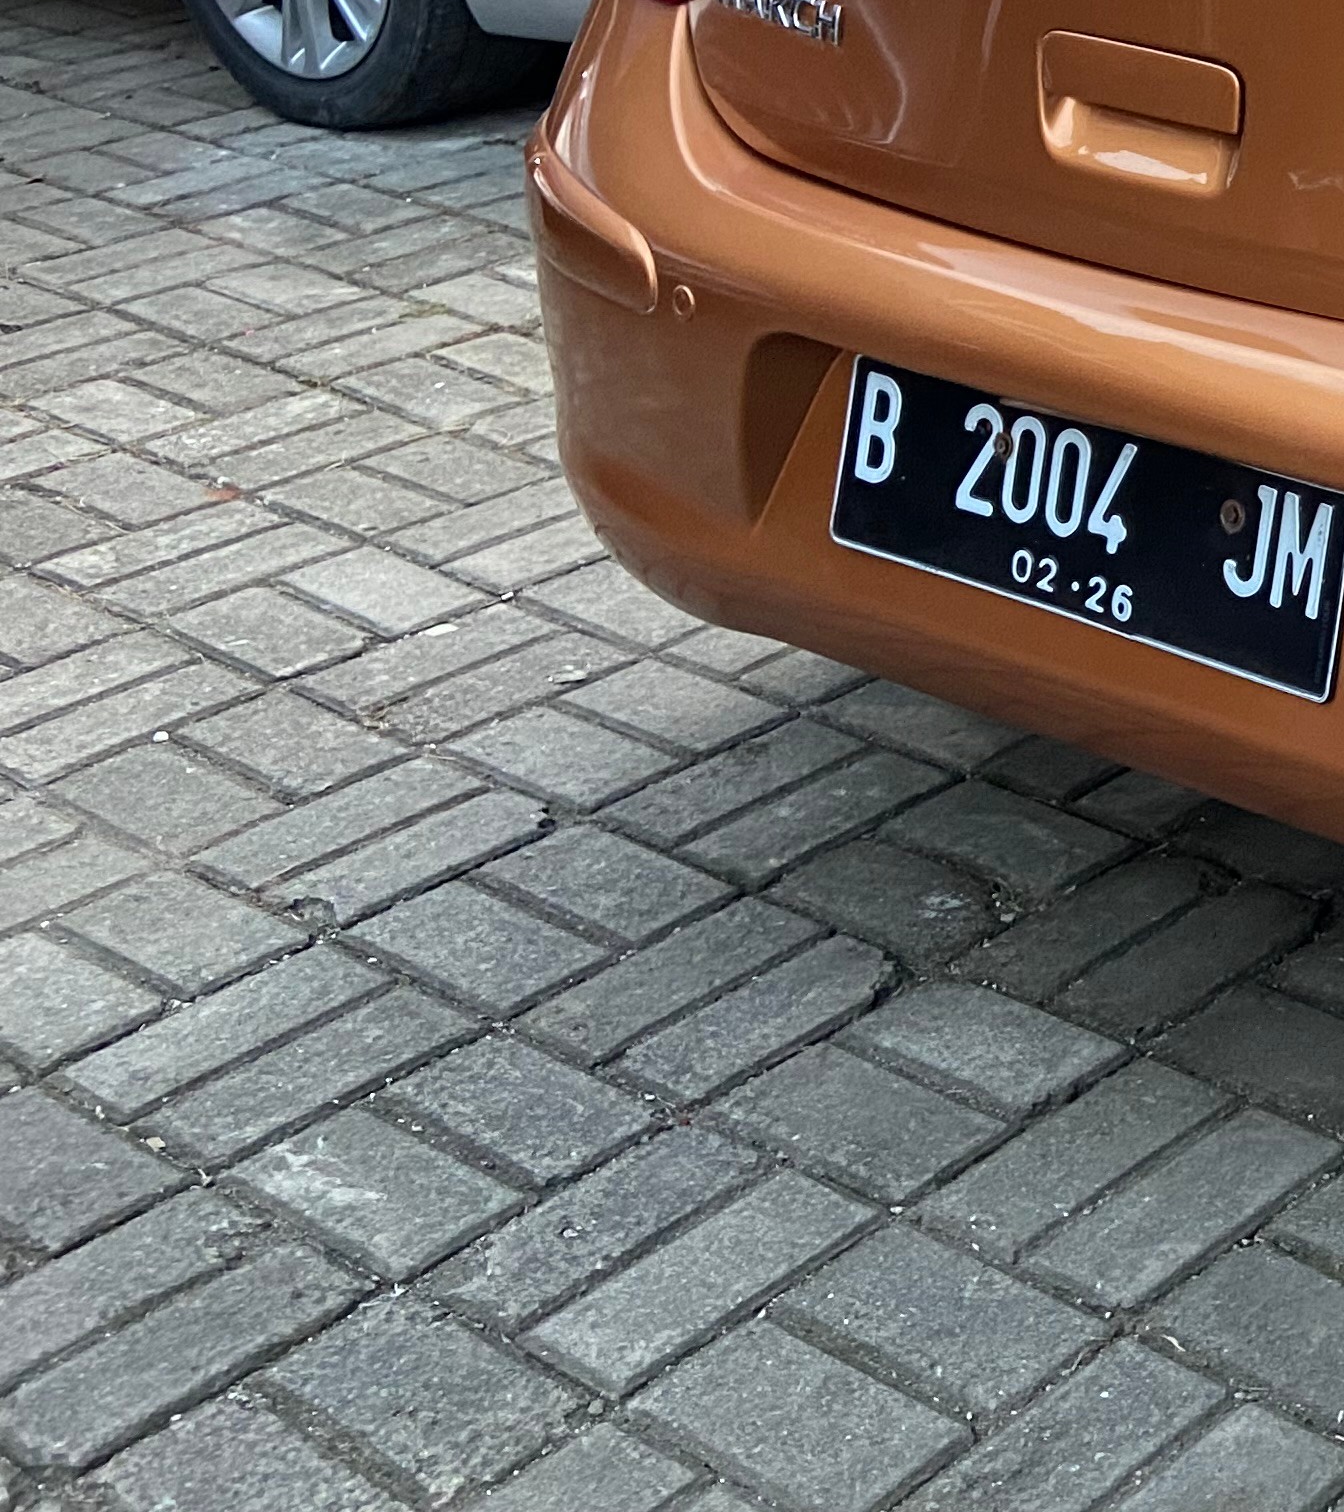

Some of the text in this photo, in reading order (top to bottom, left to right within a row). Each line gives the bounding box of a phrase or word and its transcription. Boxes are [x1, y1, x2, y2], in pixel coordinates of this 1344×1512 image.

[854, 370, 1334, 620] B 2004 JM
